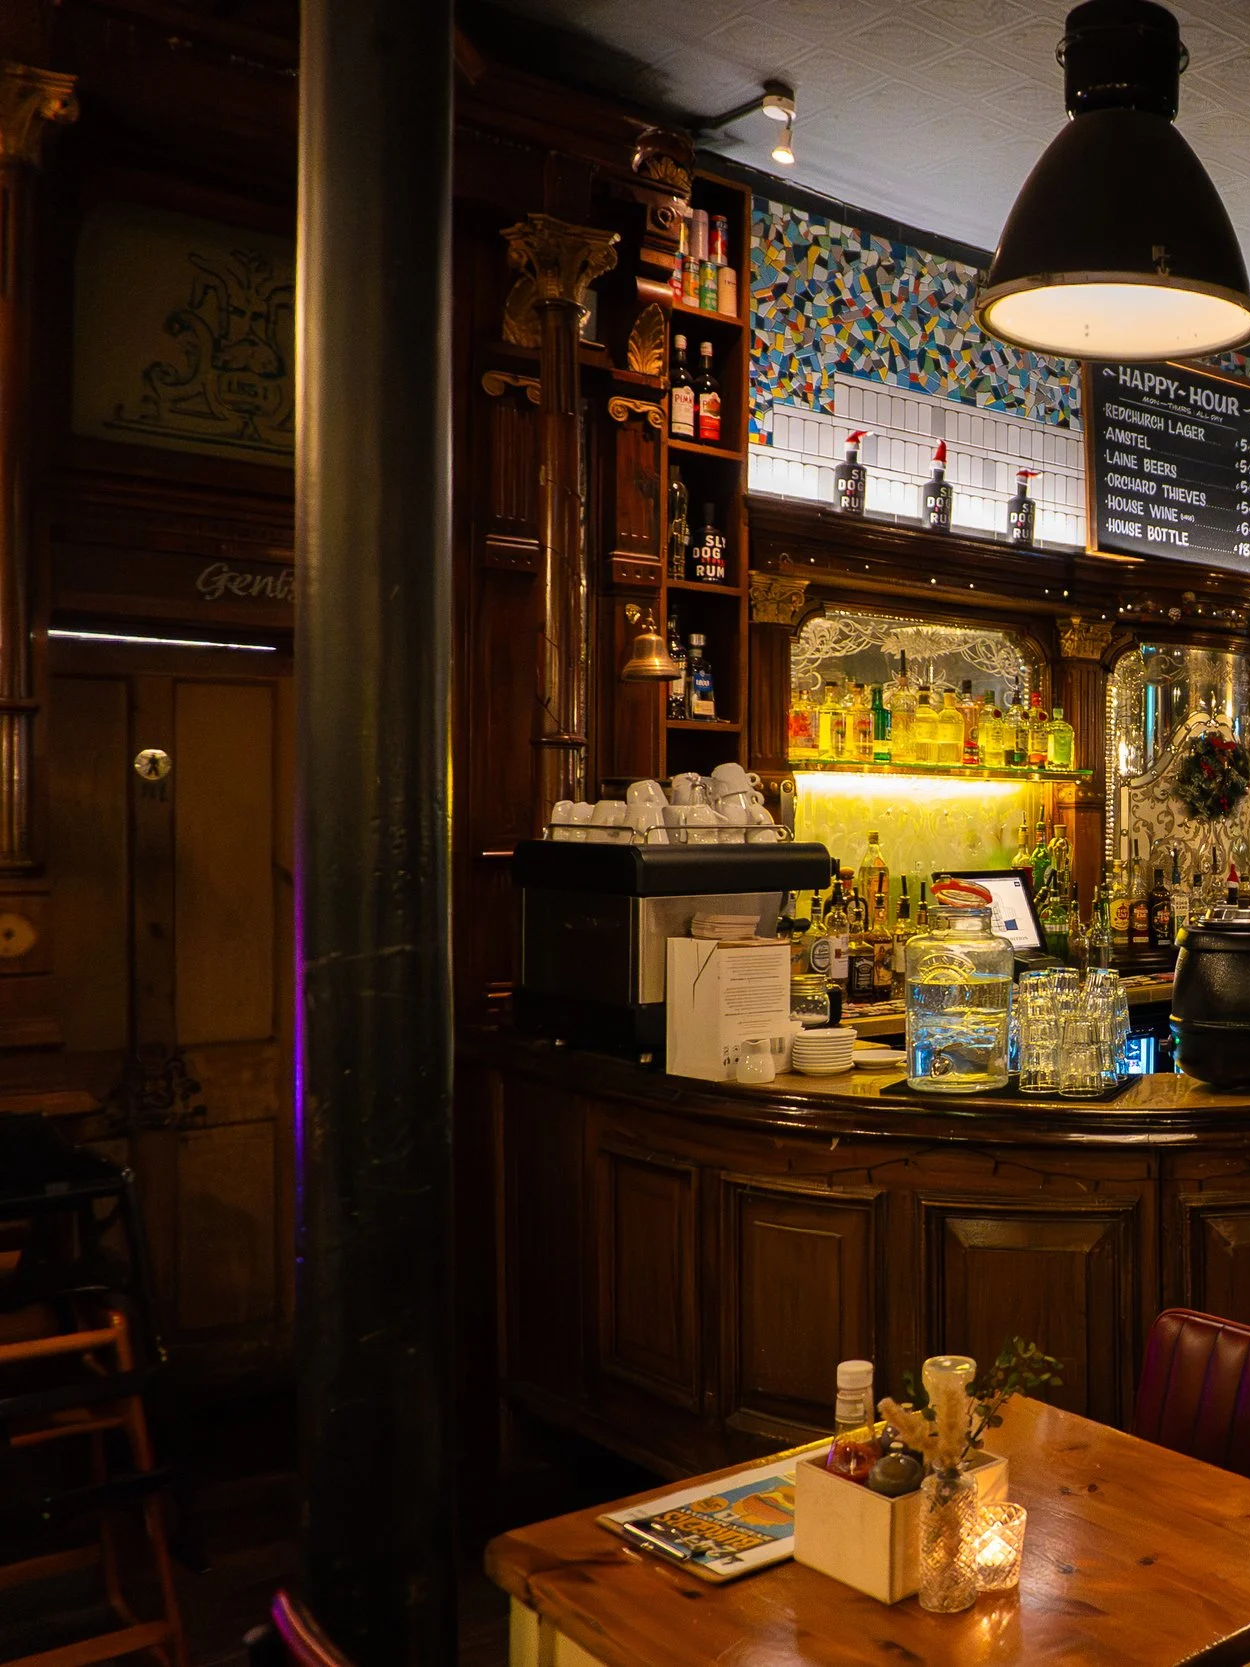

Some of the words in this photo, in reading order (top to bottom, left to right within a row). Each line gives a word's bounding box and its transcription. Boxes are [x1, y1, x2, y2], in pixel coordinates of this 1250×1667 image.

[1105, 402, 1165, 431] REDCHURCH
[1168, 420, 1206, 442] LAGER
[1105, 427, 1152, 450] AMSTEL
[1106, 449, 1139, 469] LAINE
[1144, 458, 1177, 479] BEERS
[1107, 472, 1156, 495] ORCHARD
[1162, 484, 1206, 506] THIEVES
[1107, 494, 1144, 515] HOUSE
[1149, 504, 1178, 522] WINE
[1108, 518, 1142, 538] HOUSE
[1147, 525, 1189, 547] BOTTLE
[692, 547, 721, 559] DOG
[696, 565, 725, 577] RUM
